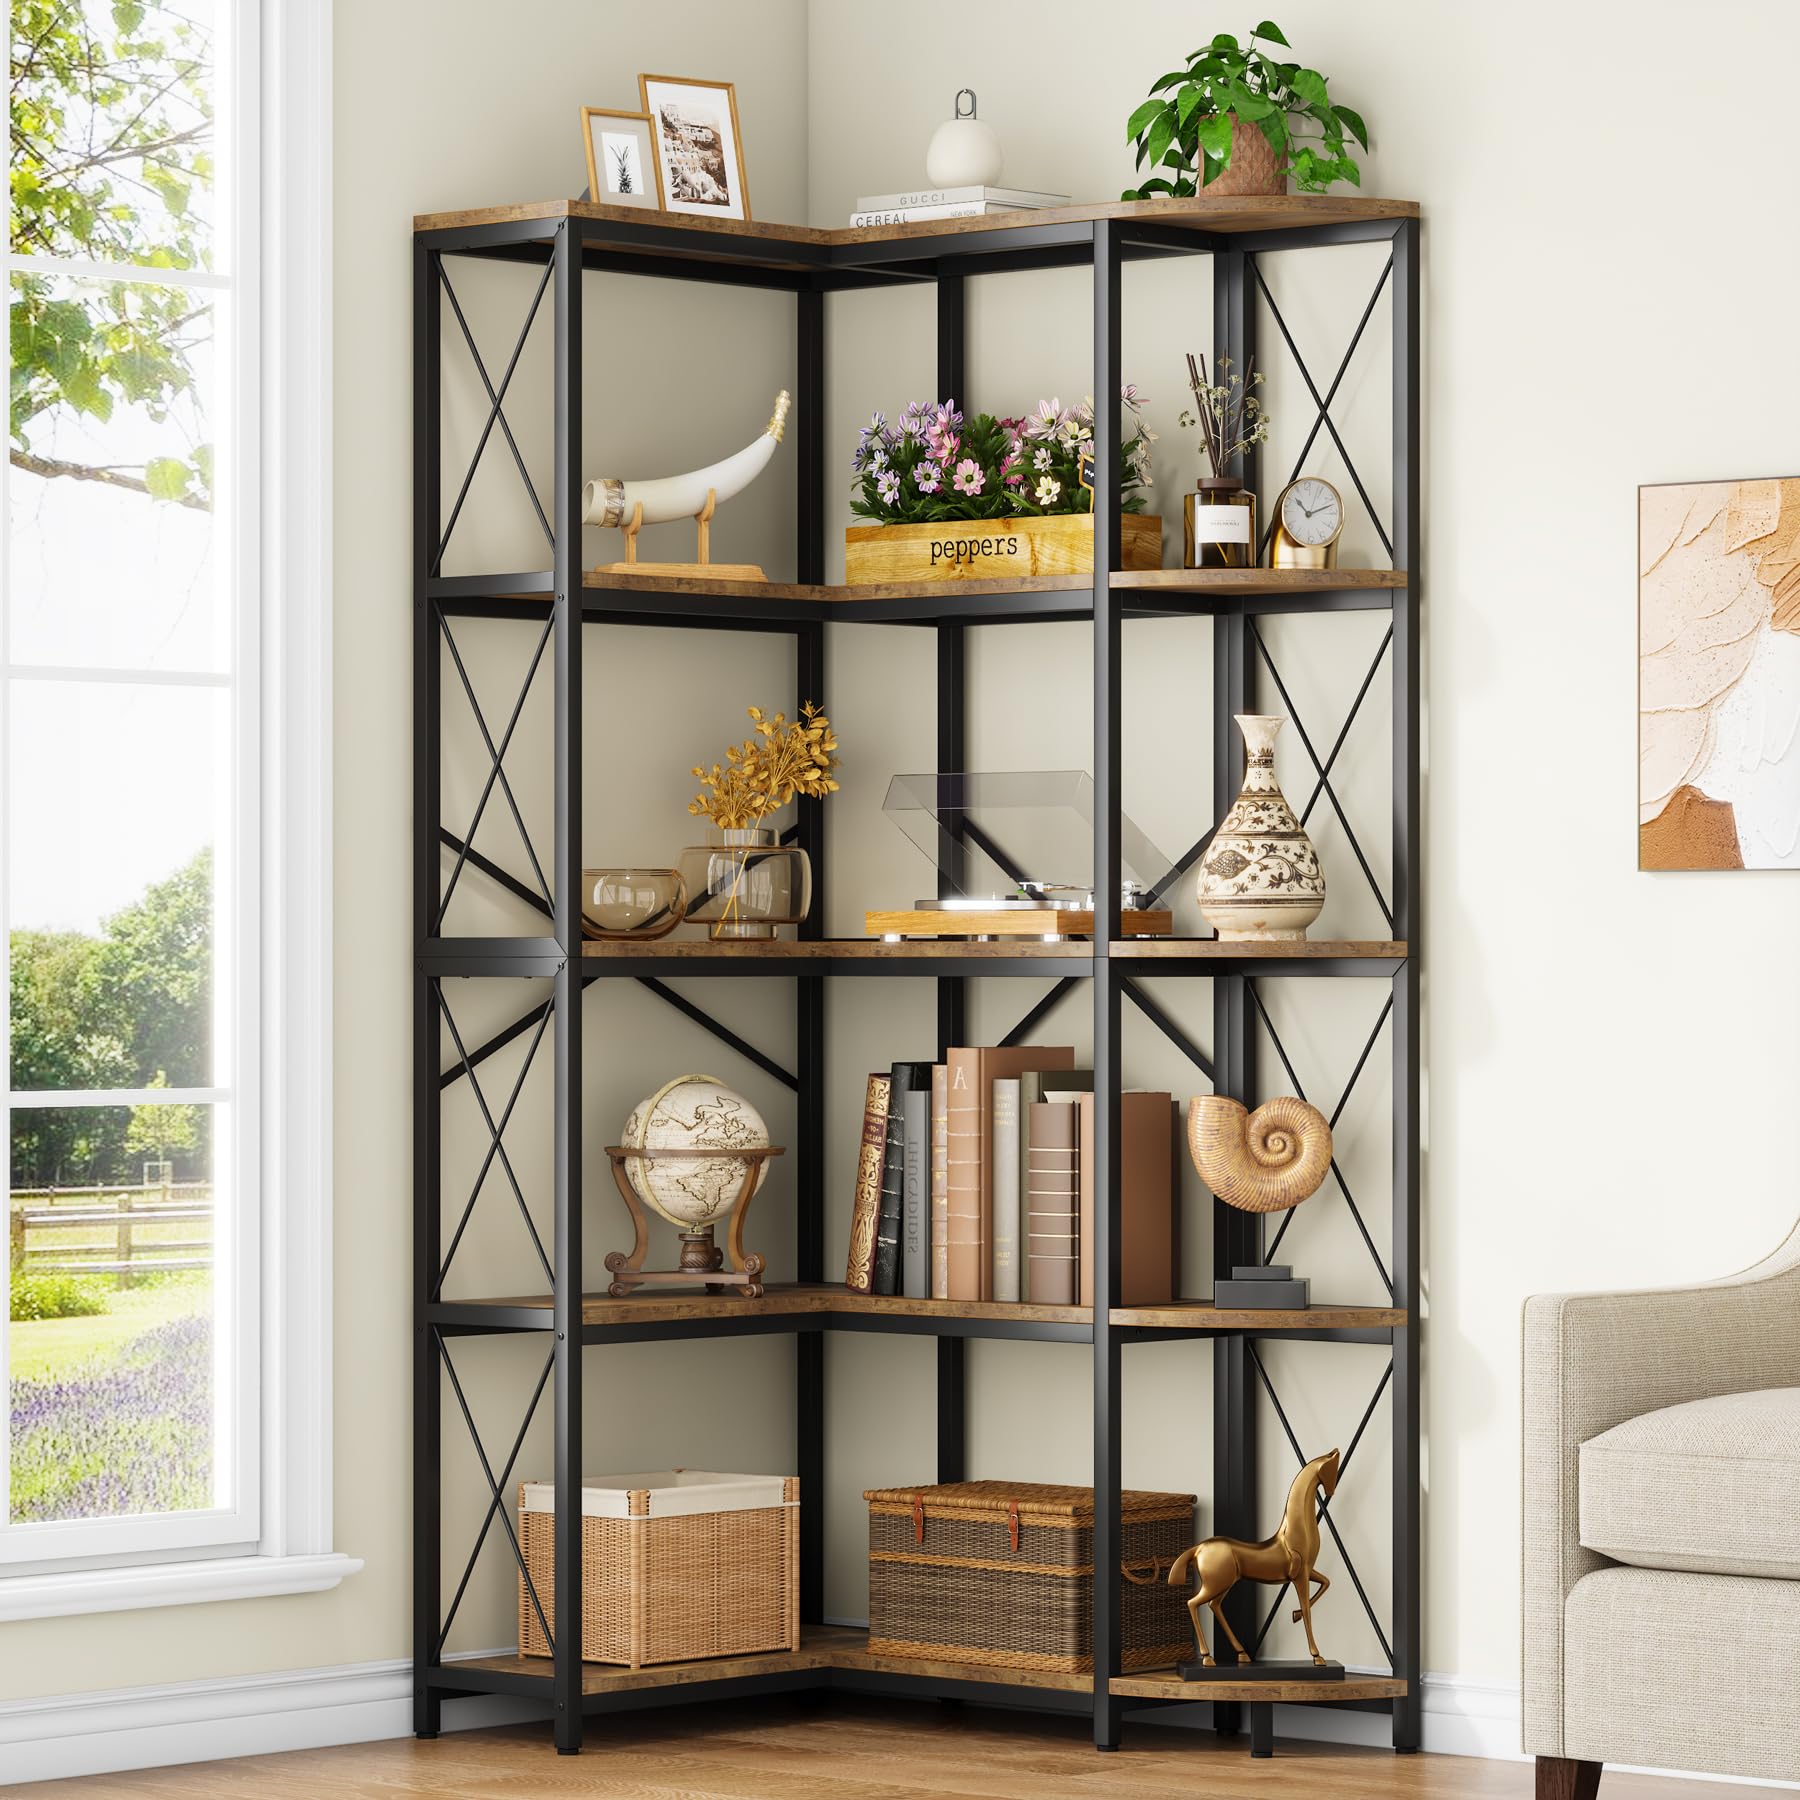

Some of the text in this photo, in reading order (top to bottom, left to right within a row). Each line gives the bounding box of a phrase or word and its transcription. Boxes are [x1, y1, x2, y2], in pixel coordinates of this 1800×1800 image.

[899, 193, 945, 206] GUCCI
[856, 212, 909, 228] CEREAL
[930, 537, 1018, 565] peppers
[952, 1066, 968, 1090] A
